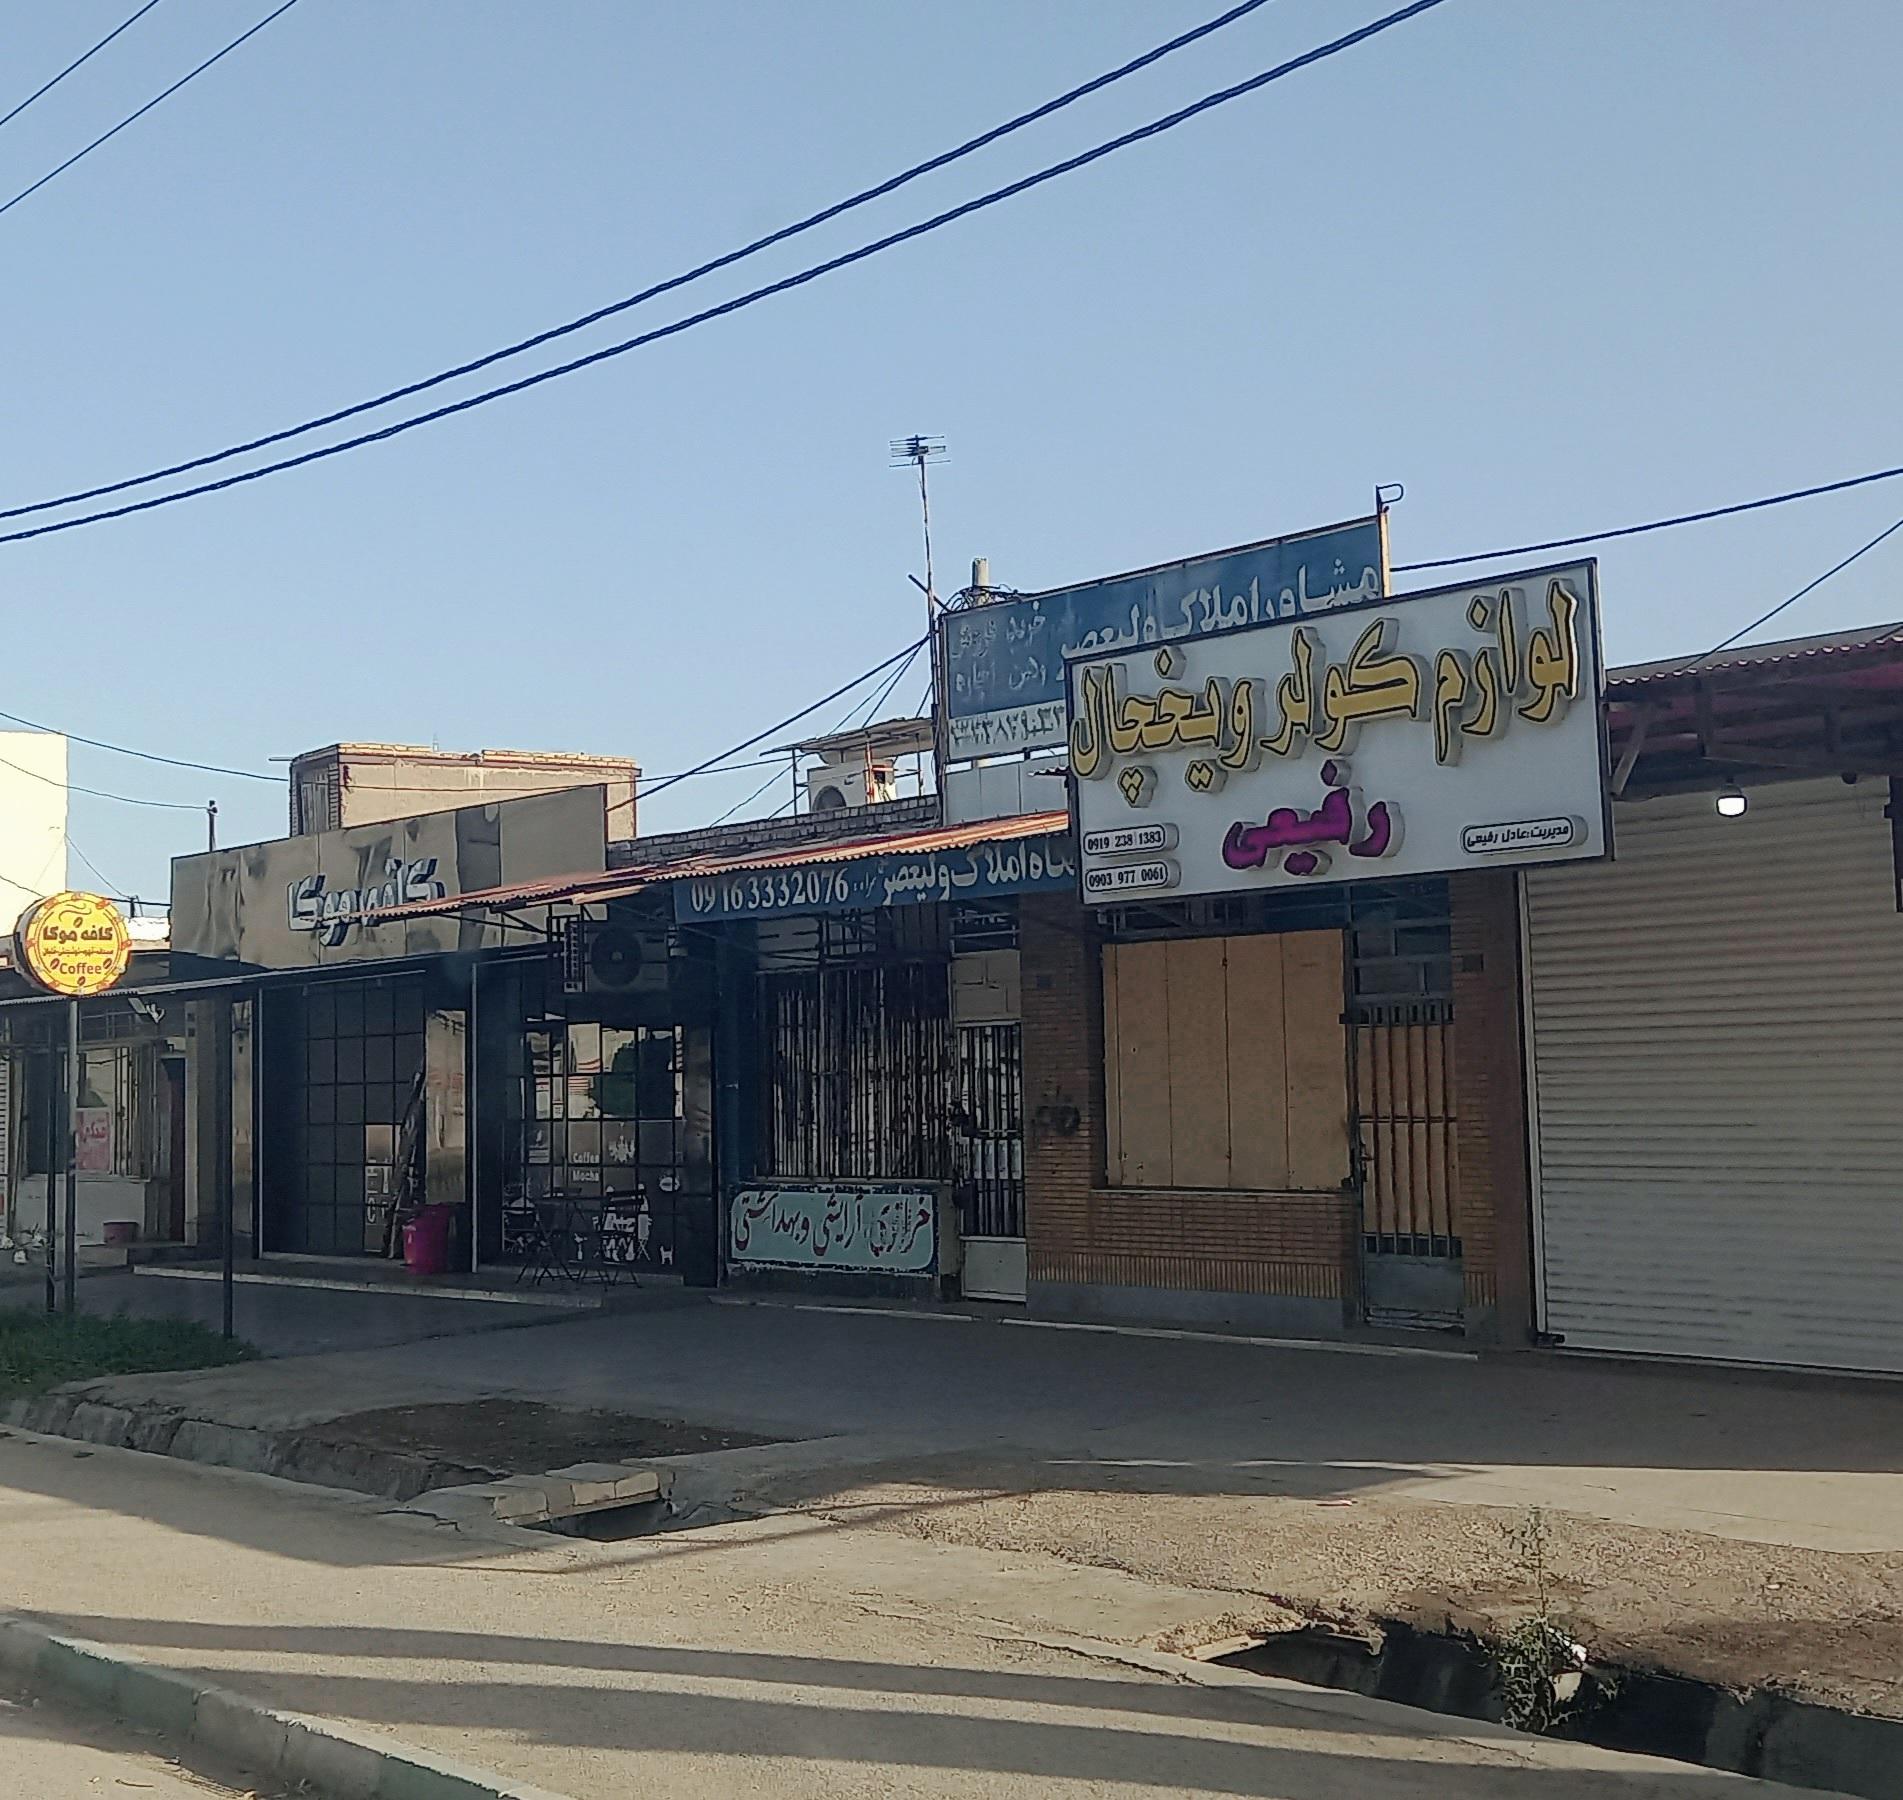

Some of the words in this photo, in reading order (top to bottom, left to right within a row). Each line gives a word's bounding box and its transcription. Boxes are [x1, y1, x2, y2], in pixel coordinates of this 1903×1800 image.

[1434, 576, 1580, 768] لوازم
[1260, 619, 1421, 754] کولر
[1222, 759, 1393, 875] رفیعی
[1087, 836, 1110, 851] 0919
[1088, 872, 1113, 888] 0903
[1117, 869, 1136, 884] 977
[43, 925, 78, 944] موکا
[80, 925, 113, 941] کافه
[59, 963, 102, 975] Coffee
